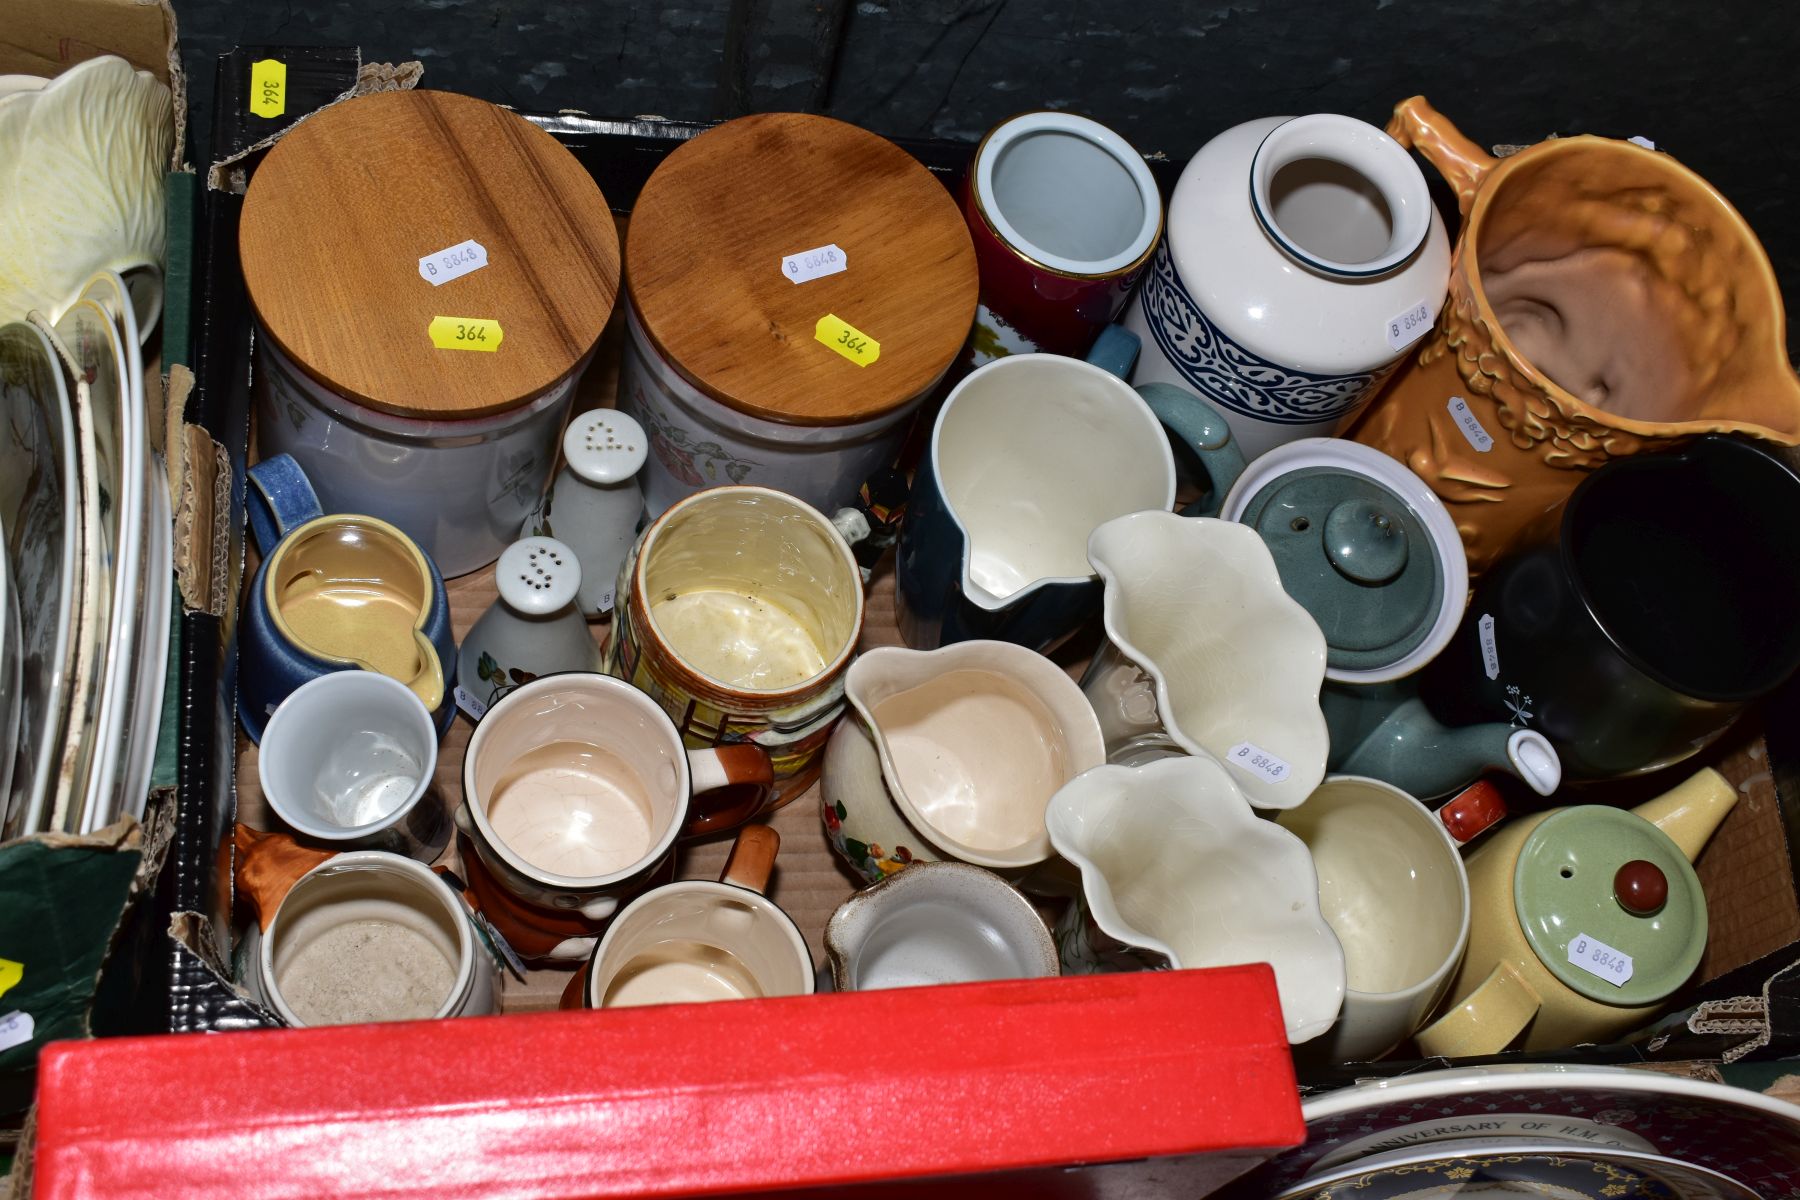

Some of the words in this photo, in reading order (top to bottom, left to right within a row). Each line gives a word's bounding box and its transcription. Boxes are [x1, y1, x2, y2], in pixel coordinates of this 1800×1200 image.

[262, 80, 280, 105] 364
[426, 262, 438, 276] B
[442, 248, 478, 269] 8848
[788, 261, 799, 274] B
[804, 250, 838, 270] 8848
[456, 324, 487, 342] 364
[1391, 324, 1400, 337] B
[1404, 306, 1427, 330] 8848
[838, 330, 867, 354] 364
[1456, 402, 1465, 411] B
[1464, 416, 1489, 443] 8848
[603, 593, 611, 604] B
[1485, 621, 1492, 631] B
[1486, 638, 1498, 671] 8848
[460, 690, 466, 701] B
[471, 700, 484, 715] 88
[1237, 747, 1250, 757] B
[1251, 755, 1283, 776] 8848
[1576, 940, 1587, 954] B
[1592, 948, 1625, 973] 8848
[1520, 1121, 1552, 1131] OF
[1559, 1126, 1599, 1141] H.M.
